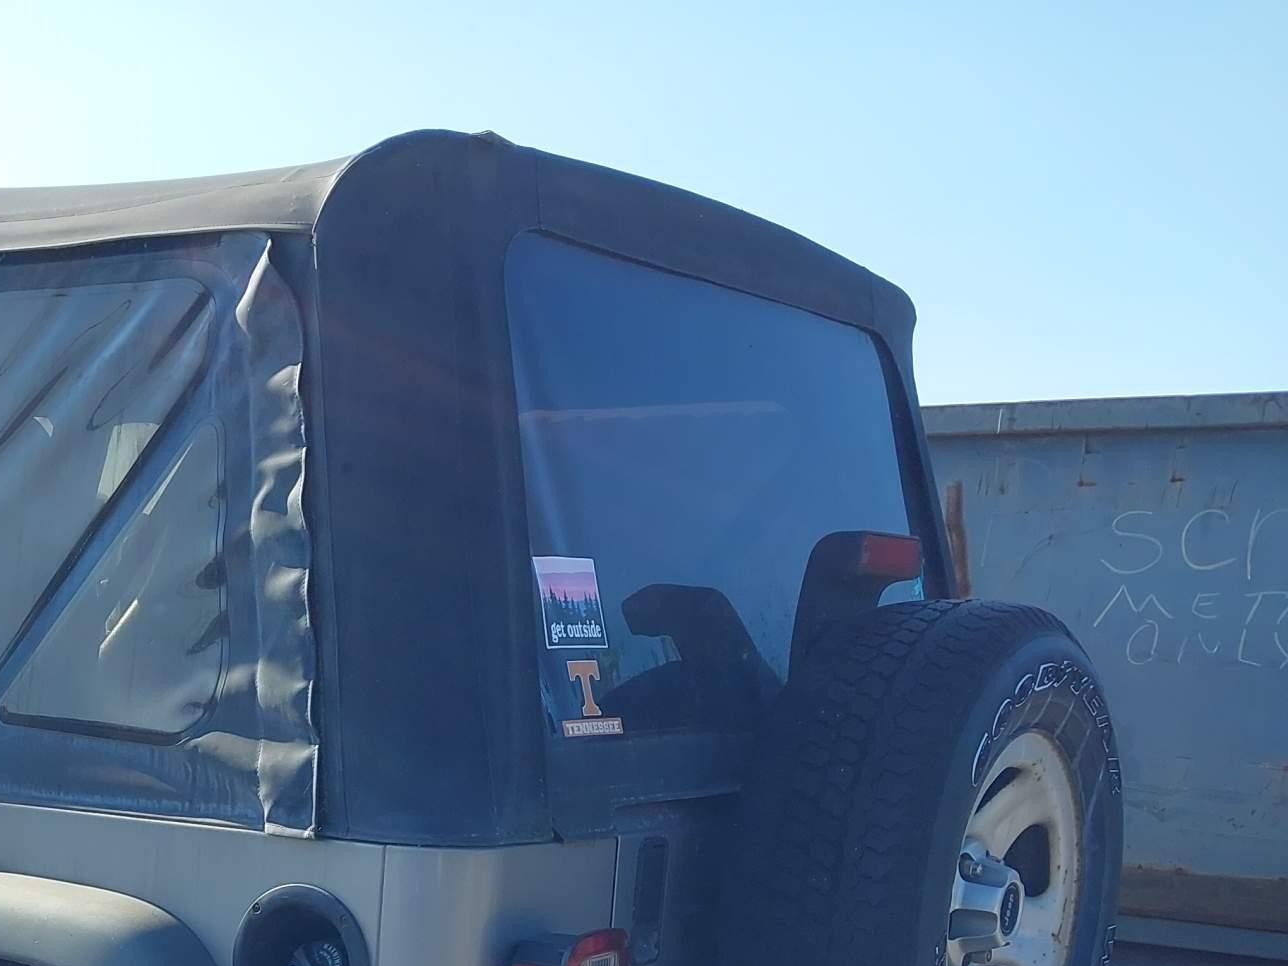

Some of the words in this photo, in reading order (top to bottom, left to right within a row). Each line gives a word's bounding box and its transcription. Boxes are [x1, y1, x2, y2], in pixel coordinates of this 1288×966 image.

[551, 621, 566, 643] get
[567, 619, 602, 638] outside
[567, 660, 602, 717] T
[565, 720, 621, 735] TENNESSEE
